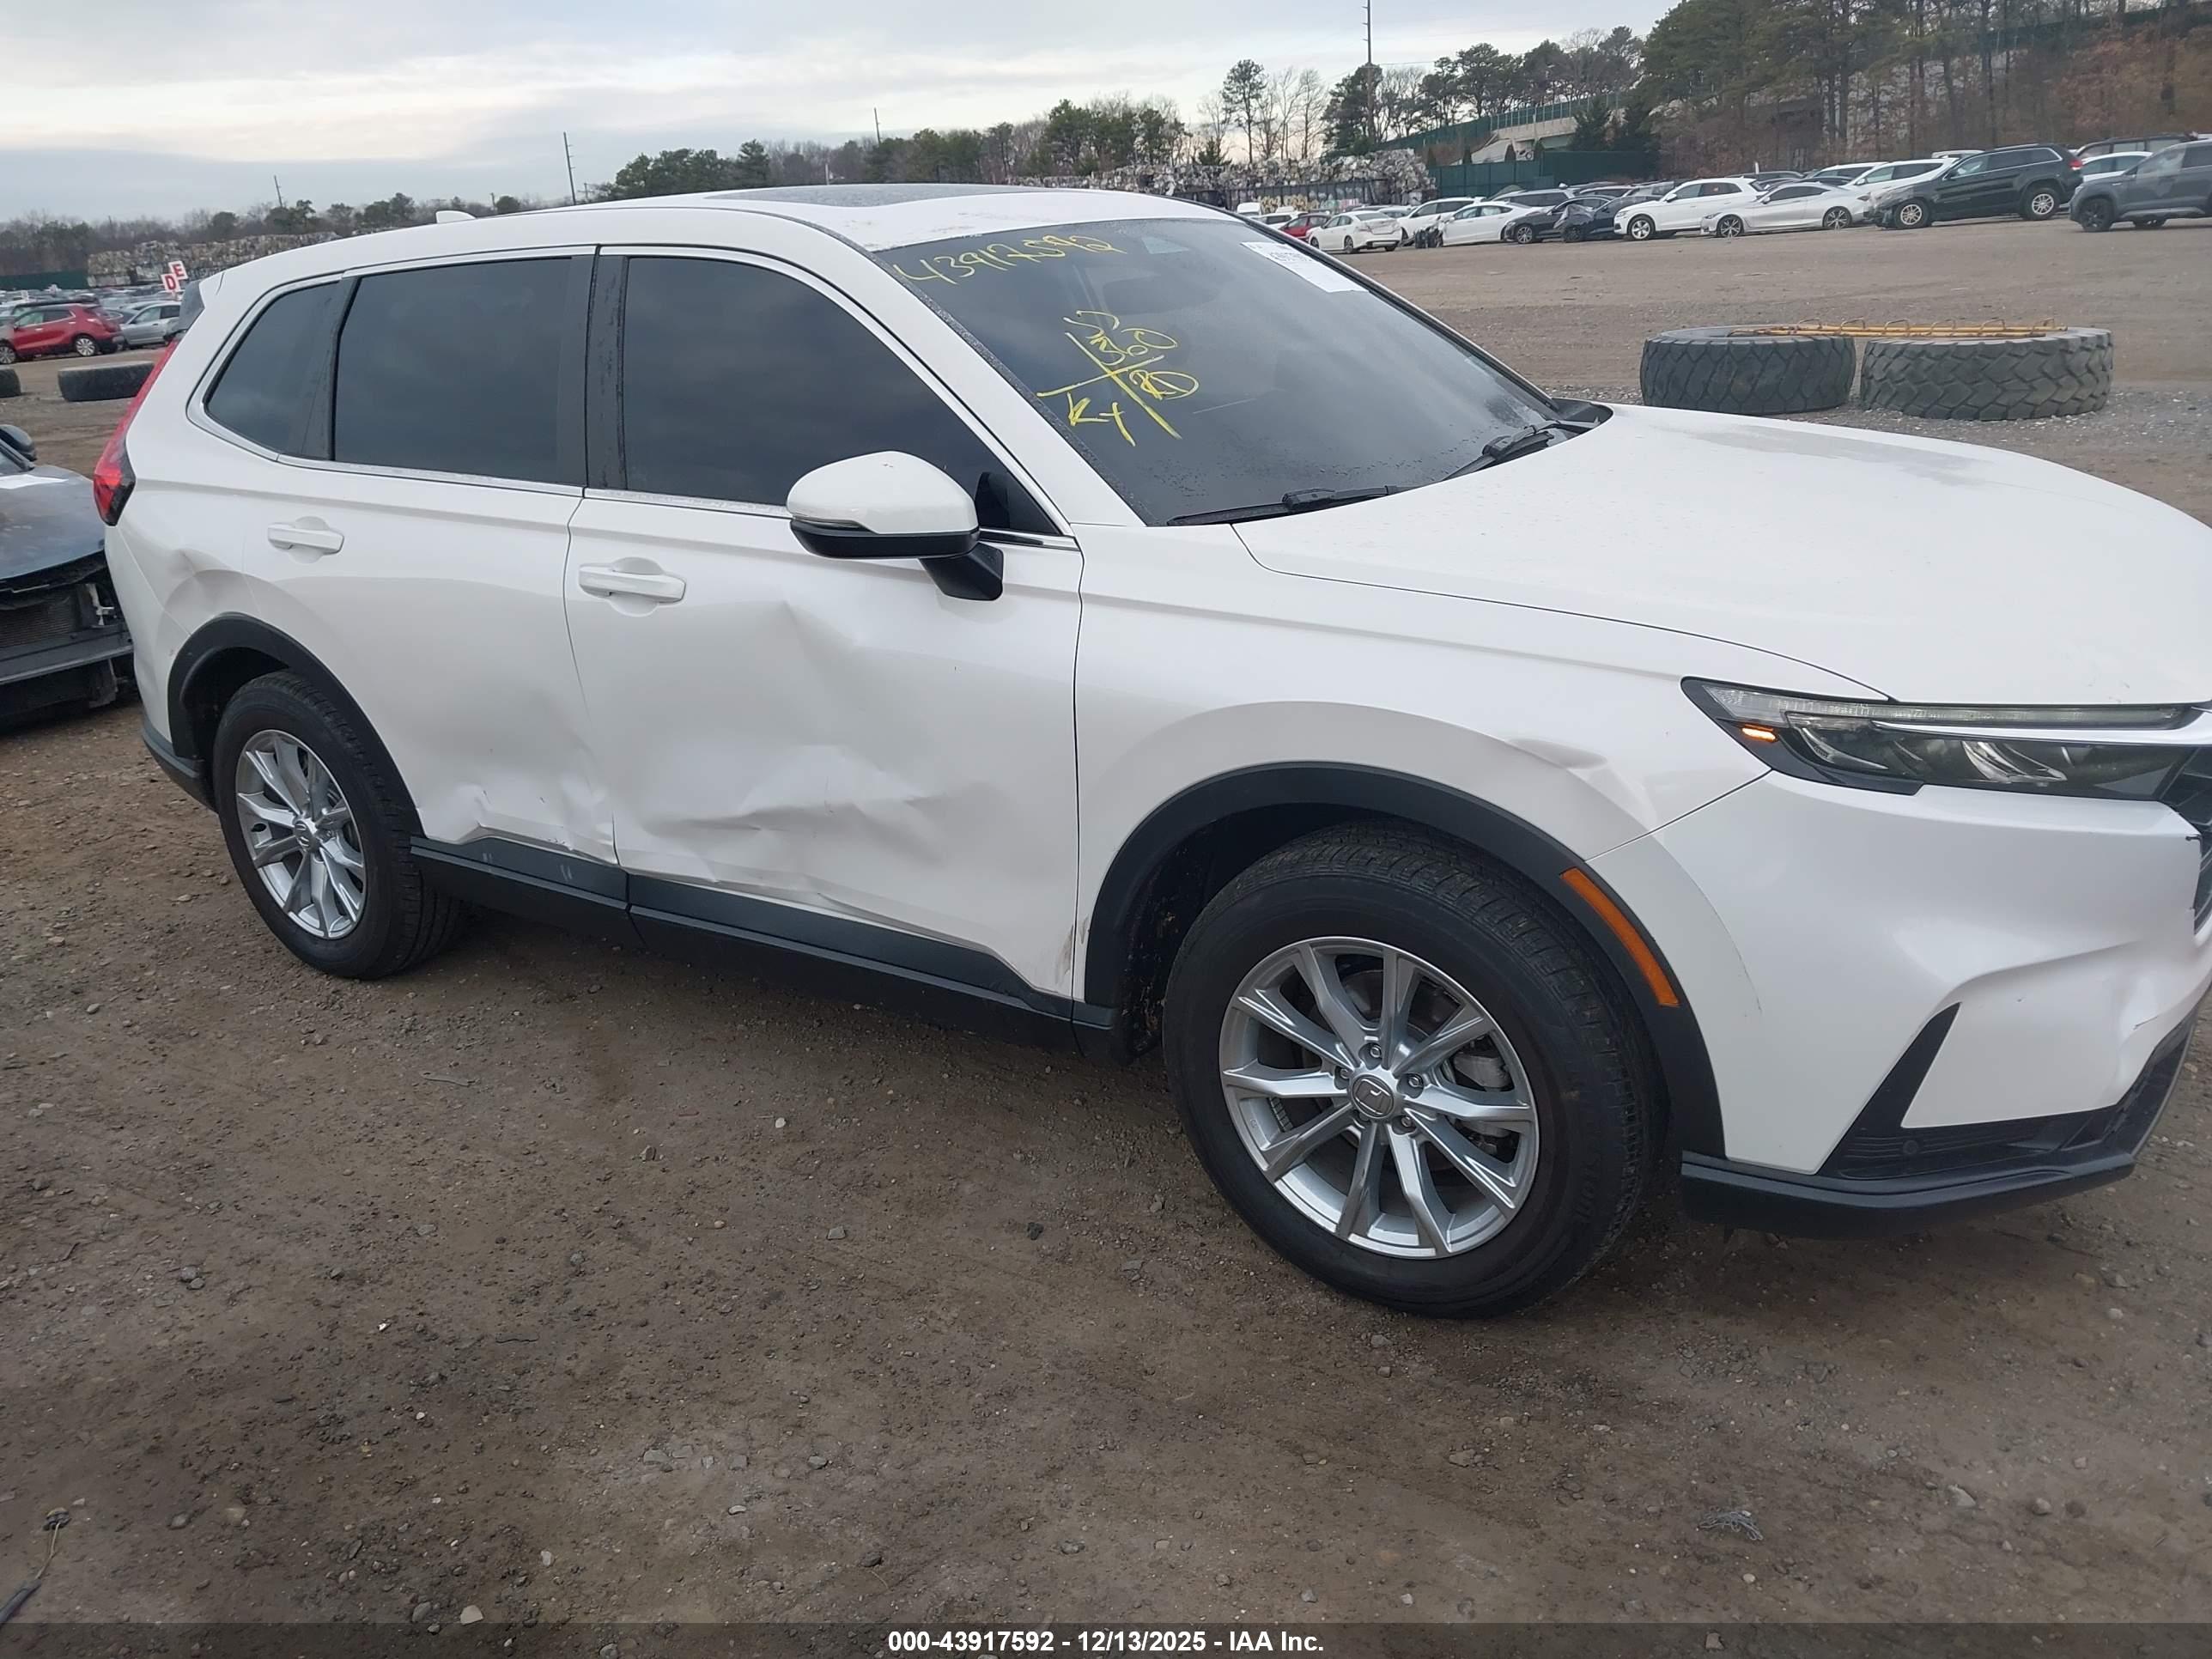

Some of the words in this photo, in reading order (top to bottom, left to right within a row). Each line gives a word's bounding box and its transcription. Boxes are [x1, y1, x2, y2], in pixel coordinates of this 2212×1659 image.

[892, 234, 1127, 285] 43917592
[172, 264, 185, 277] E
[164, 275, 176, 290] D
